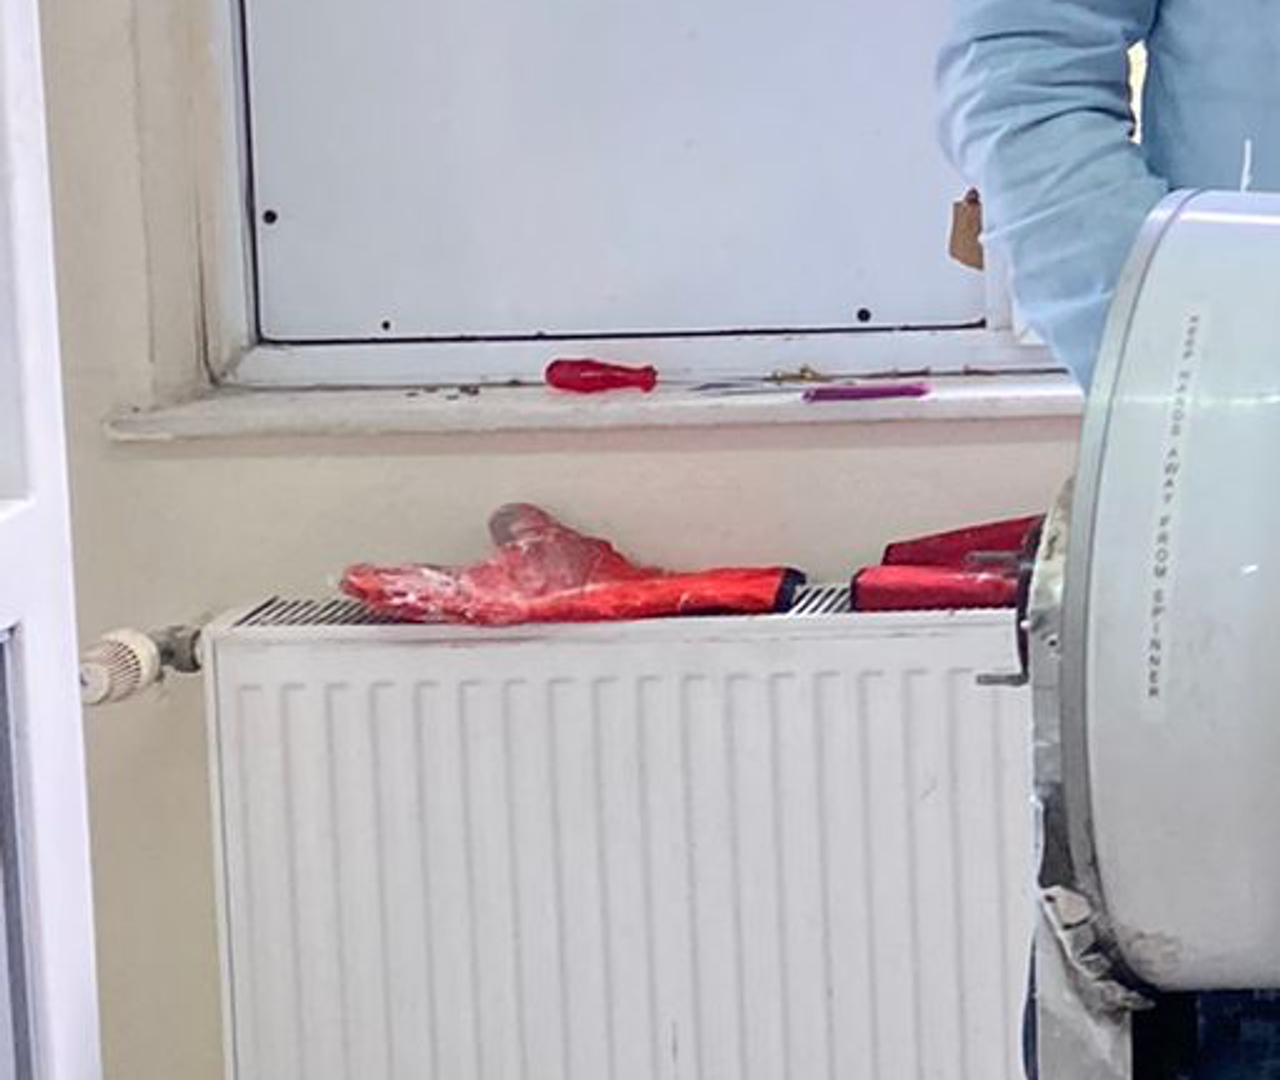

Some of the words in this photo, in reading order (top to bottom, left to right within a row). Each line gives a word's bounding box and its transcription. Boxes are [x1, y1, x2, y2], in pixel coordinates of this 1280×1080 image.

[1163, 446, 1180, 504] AWAY
[1154, 515, 1170, 578] FROM
[1148, 588, 1164, 698] SPINNER
